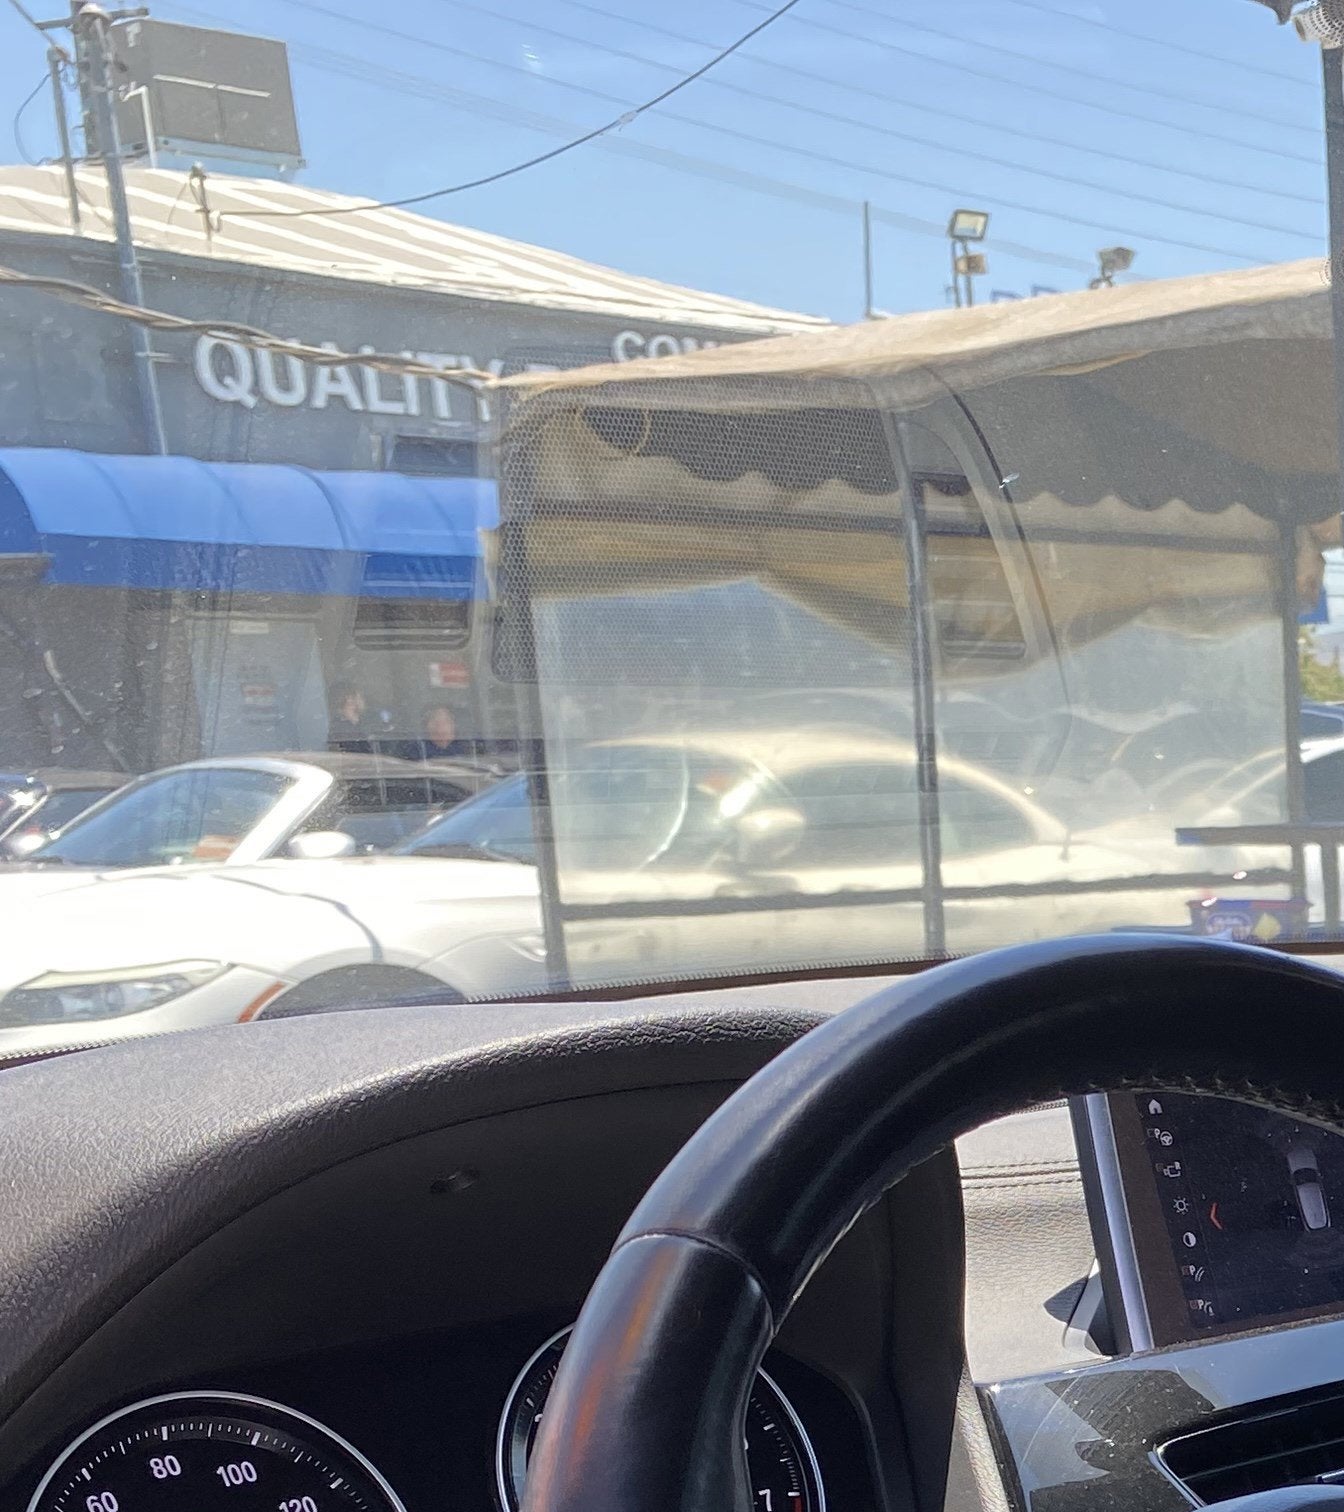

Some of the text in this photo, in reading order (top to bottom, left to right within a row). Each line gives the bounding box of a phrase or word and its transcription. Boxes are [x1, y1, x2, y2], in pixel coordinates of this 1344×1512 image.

[194, 332, 505, 424] QUALITY
[149, 1454, 182, 1480] 80
[216, 1460, 258, 1488] 100
[758, 1488, 773, 1512] 7
